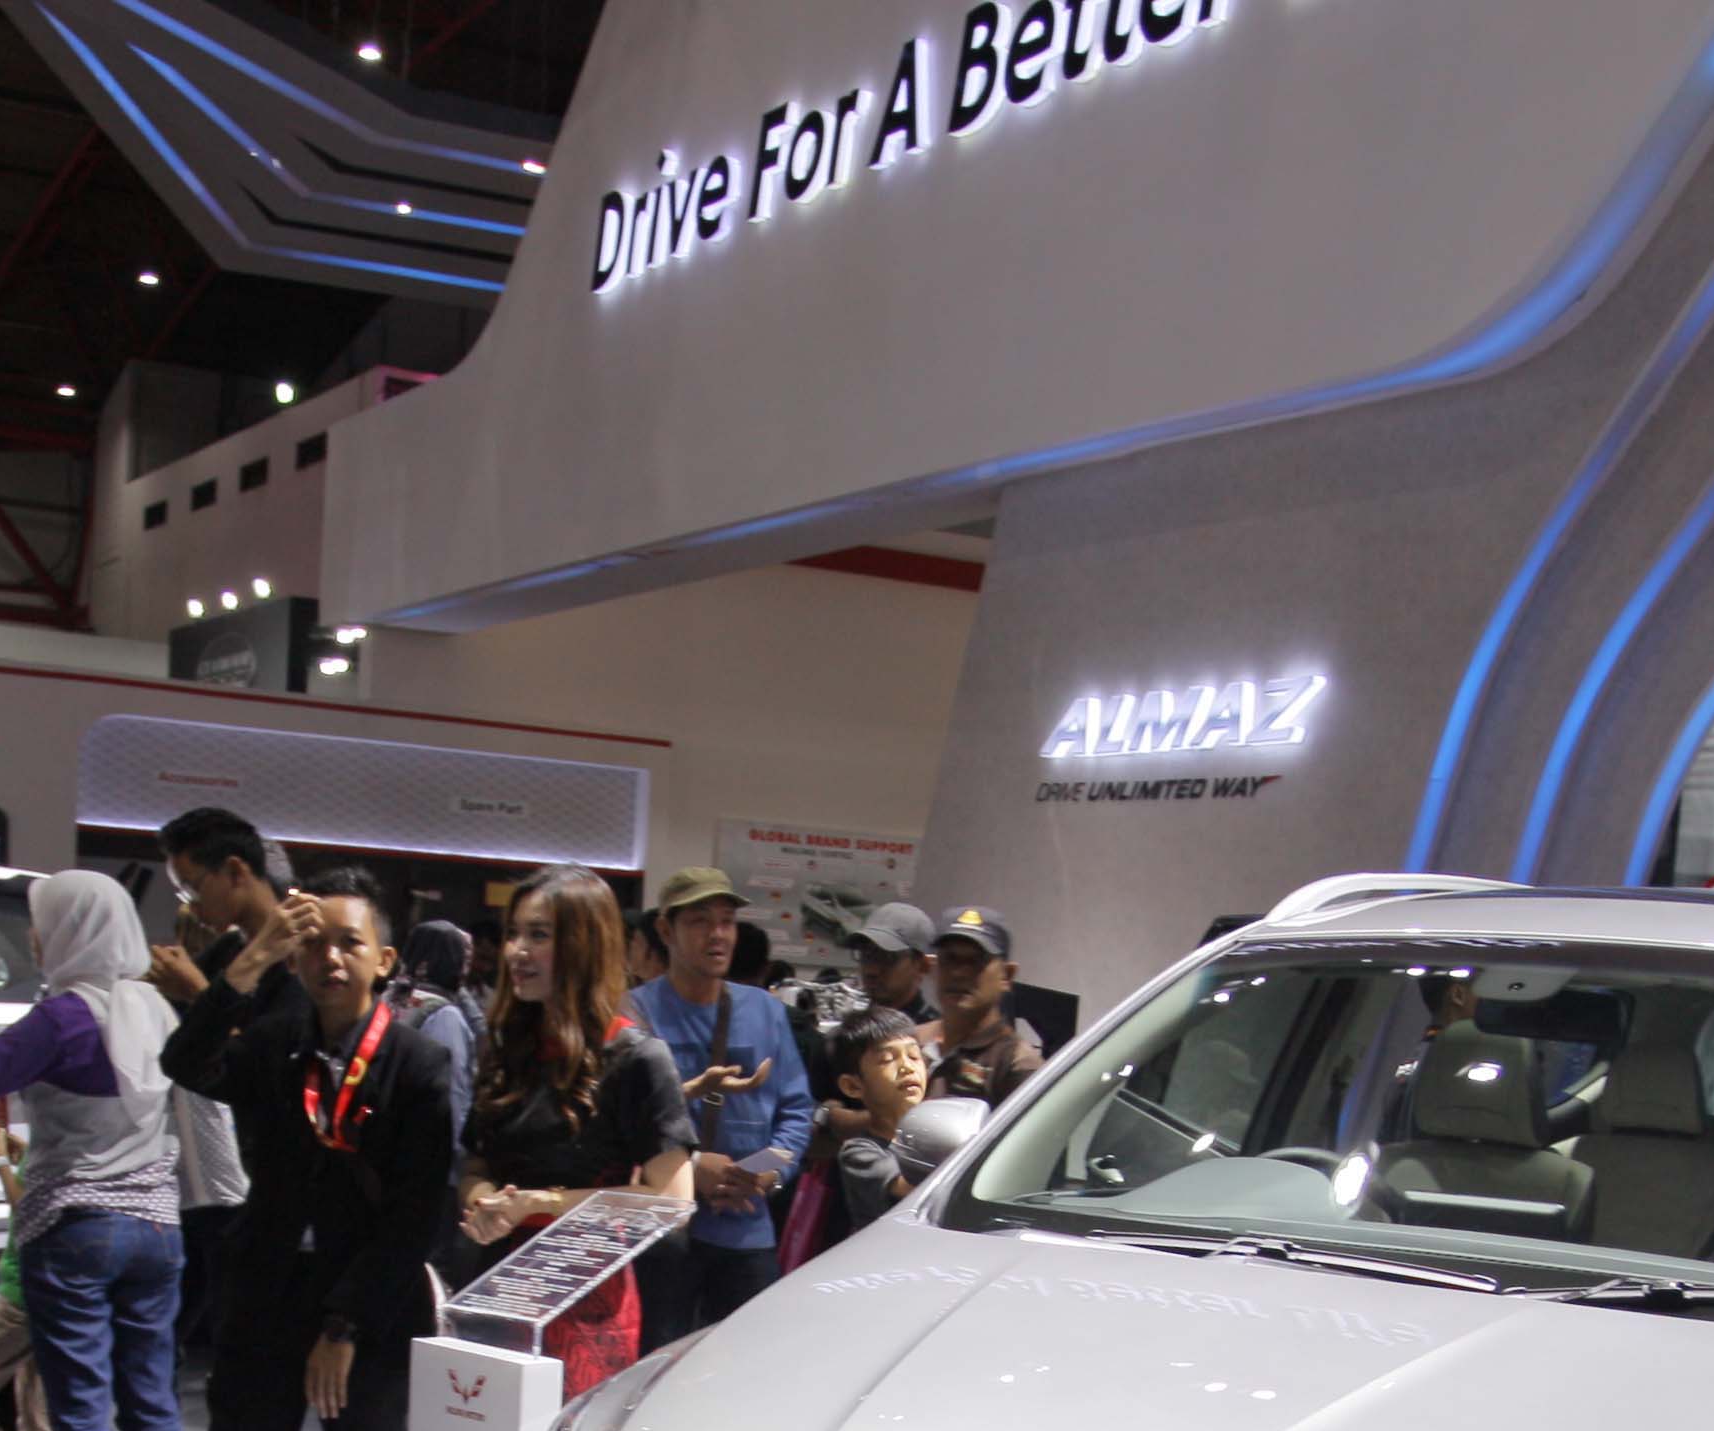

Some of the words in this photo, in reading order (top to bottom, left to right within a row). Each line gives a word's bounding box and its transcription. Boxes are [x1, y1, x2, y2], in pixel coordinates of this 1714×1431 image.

[592, 148, 741, 294] Drive
[748, 89, 874, 223] For
[868, 36, 932, 169] A
[946, 0, 1228, 137] Bett
[1038, 674, 1327, 759] ALMAZ
[1086, 778, 1207, 801] UNLIMITED
[1211, 775, 1265, 798] WAY
